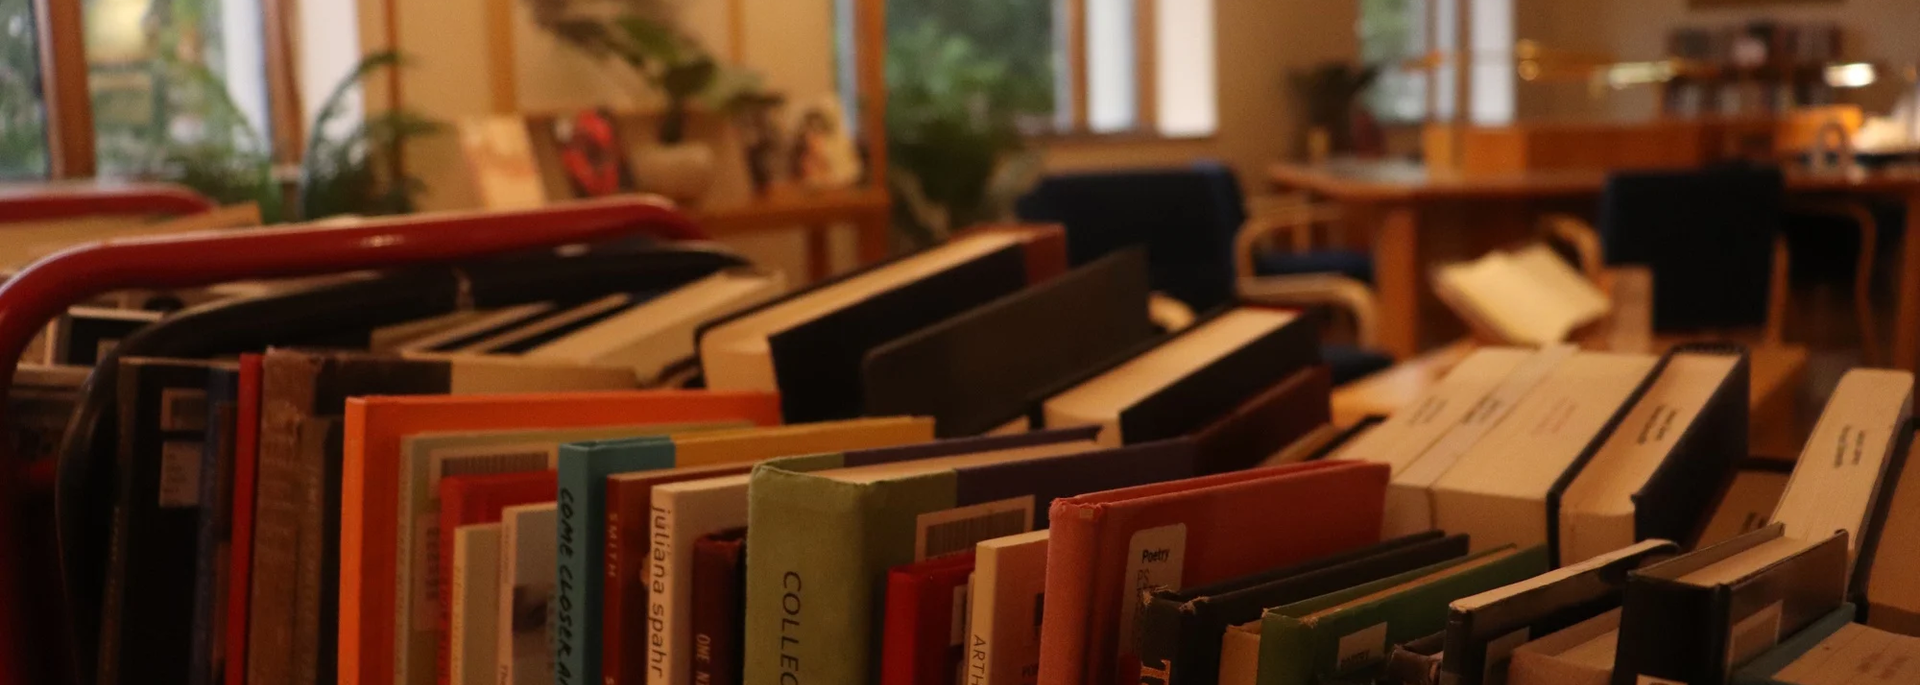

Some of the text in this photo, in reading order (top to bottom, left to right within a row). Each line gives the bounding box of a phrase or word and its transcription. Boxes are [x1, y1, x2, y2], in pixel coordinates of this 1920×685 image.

[560, 487, 575, 558] COME
[606, 512, 619, 578] SMITH
[1142, 548, 1171, 564] Poetry
[558, 565, 574, 658] CLOSER
[647, 506, 671, 679] juliana spahr
[695, 632, 711, 663] ONE
